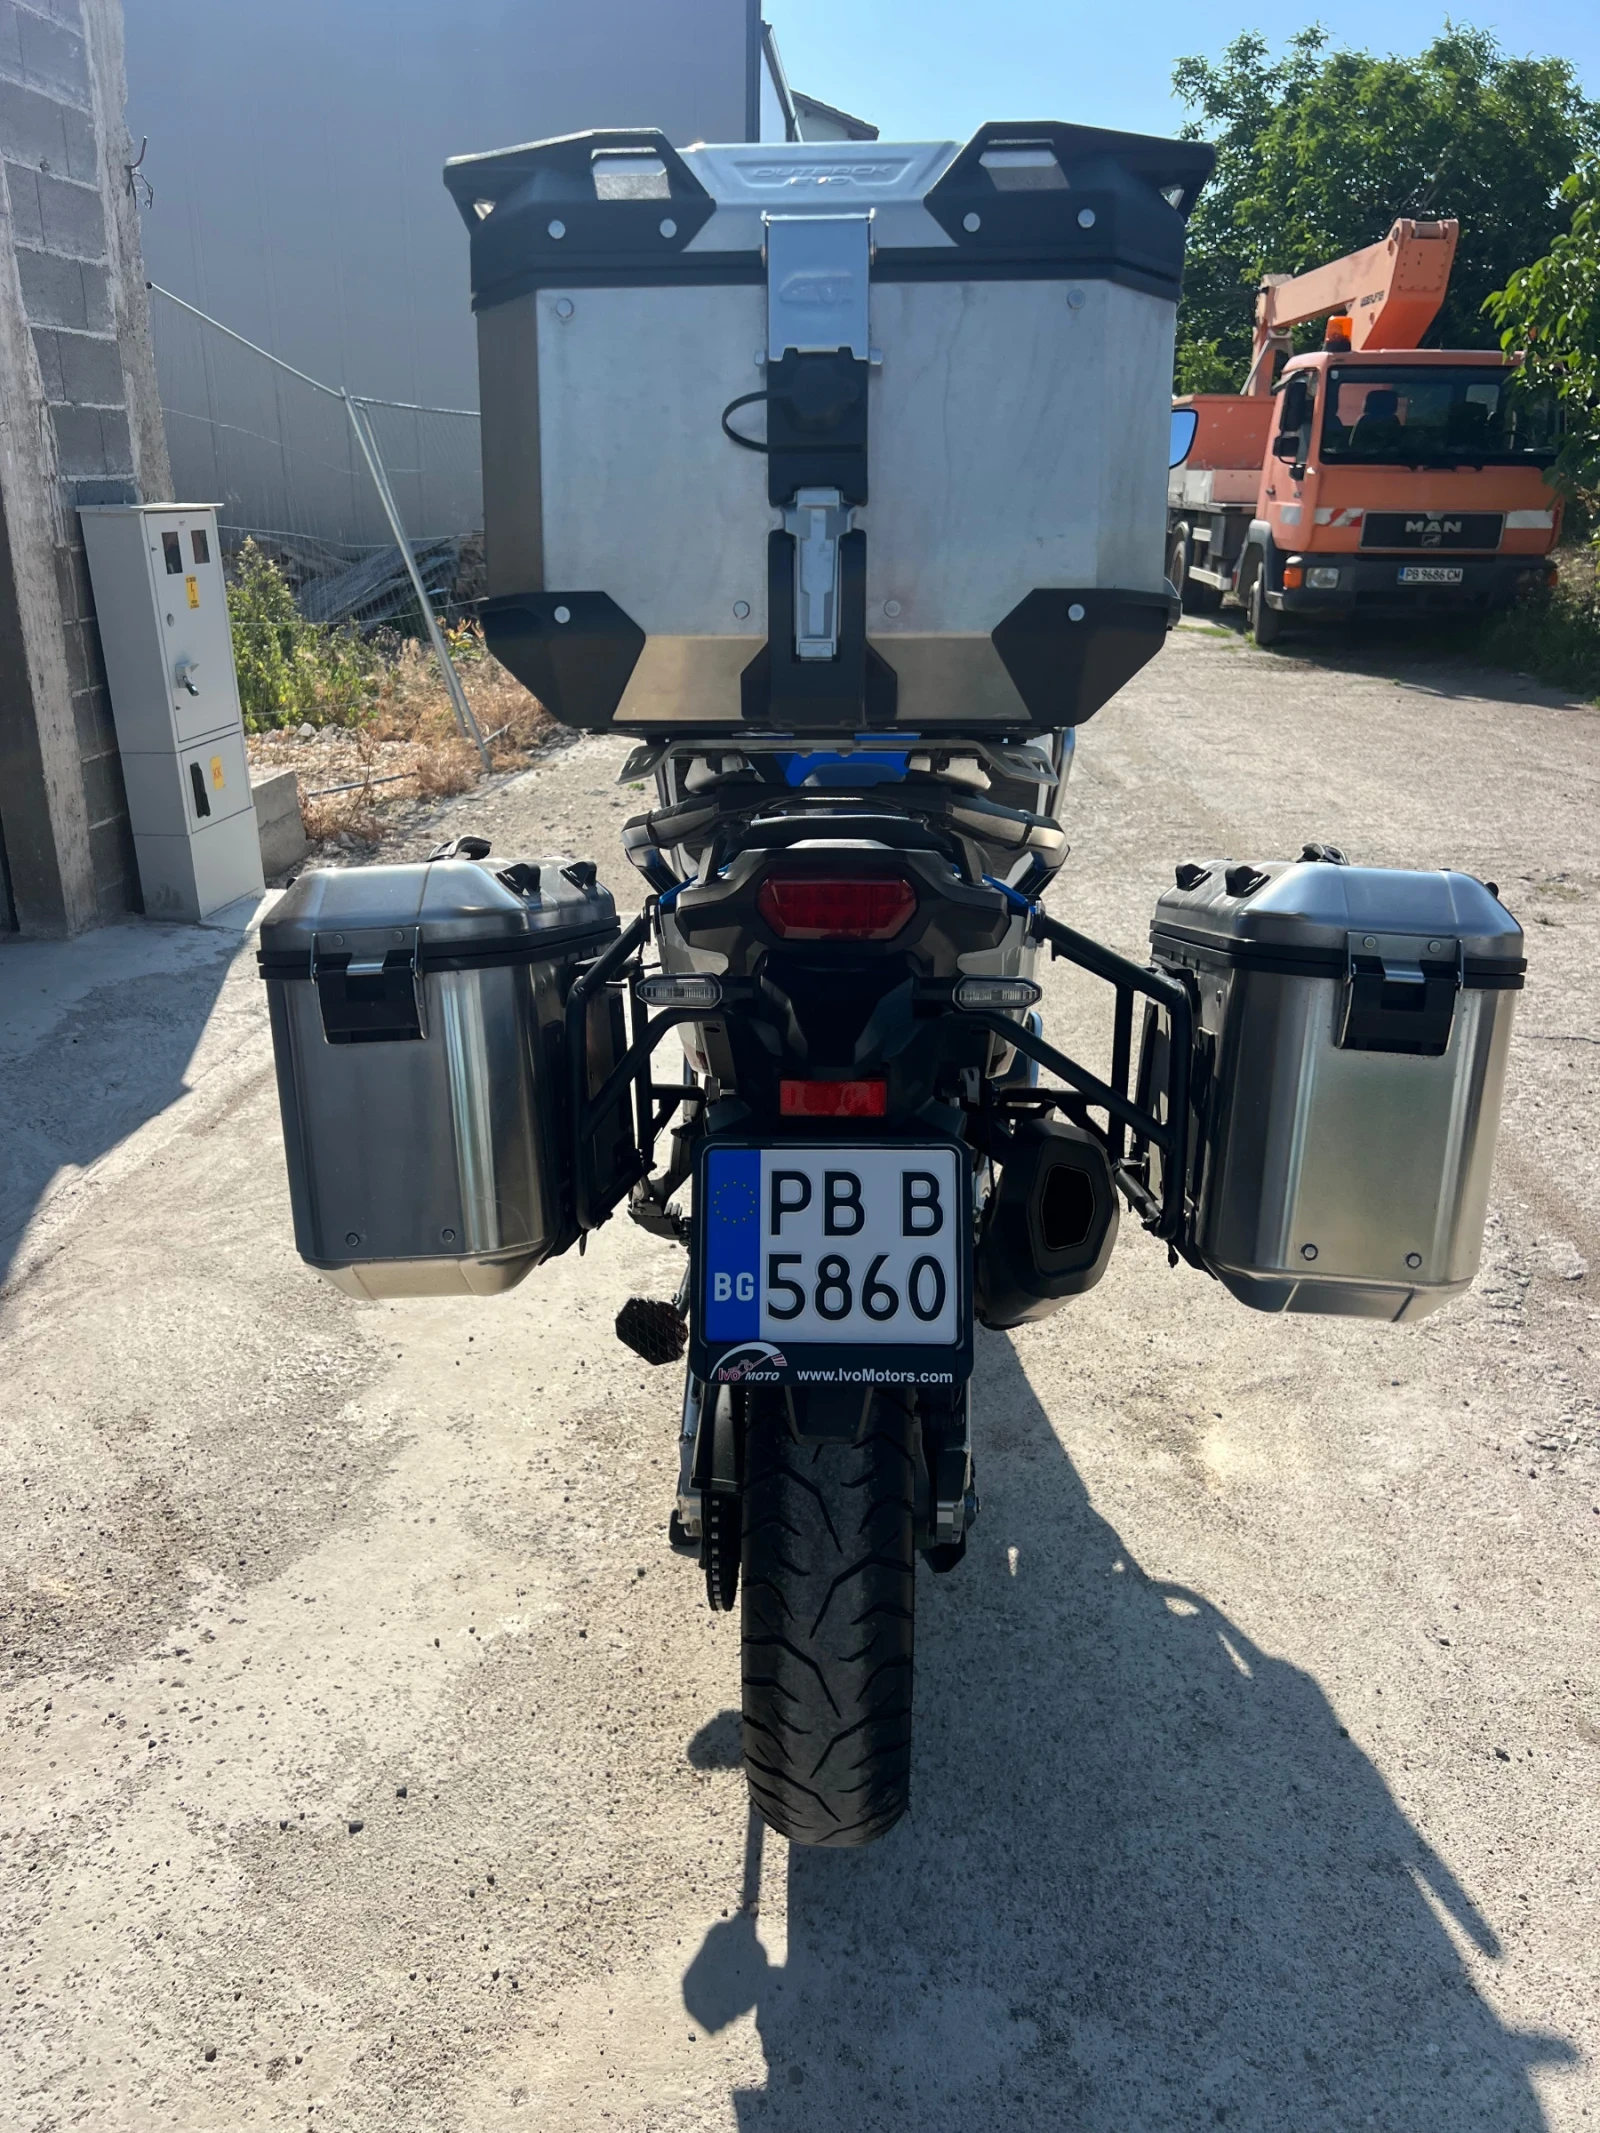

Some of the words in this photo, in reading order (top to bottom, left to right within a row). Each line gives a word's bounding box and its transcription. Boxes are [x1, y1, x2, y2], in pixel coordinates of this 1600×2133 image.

[1405, 520, 1462, 533] MAN
[770, 1170, 866, 1237] PB
[902, 1171, 944, 1237] B
[713, 1272, 755, 1301] BG
[767, 1253, 946, 1322] 5860
[797, 1367, 954, 1384] www.IvoMotors.com
